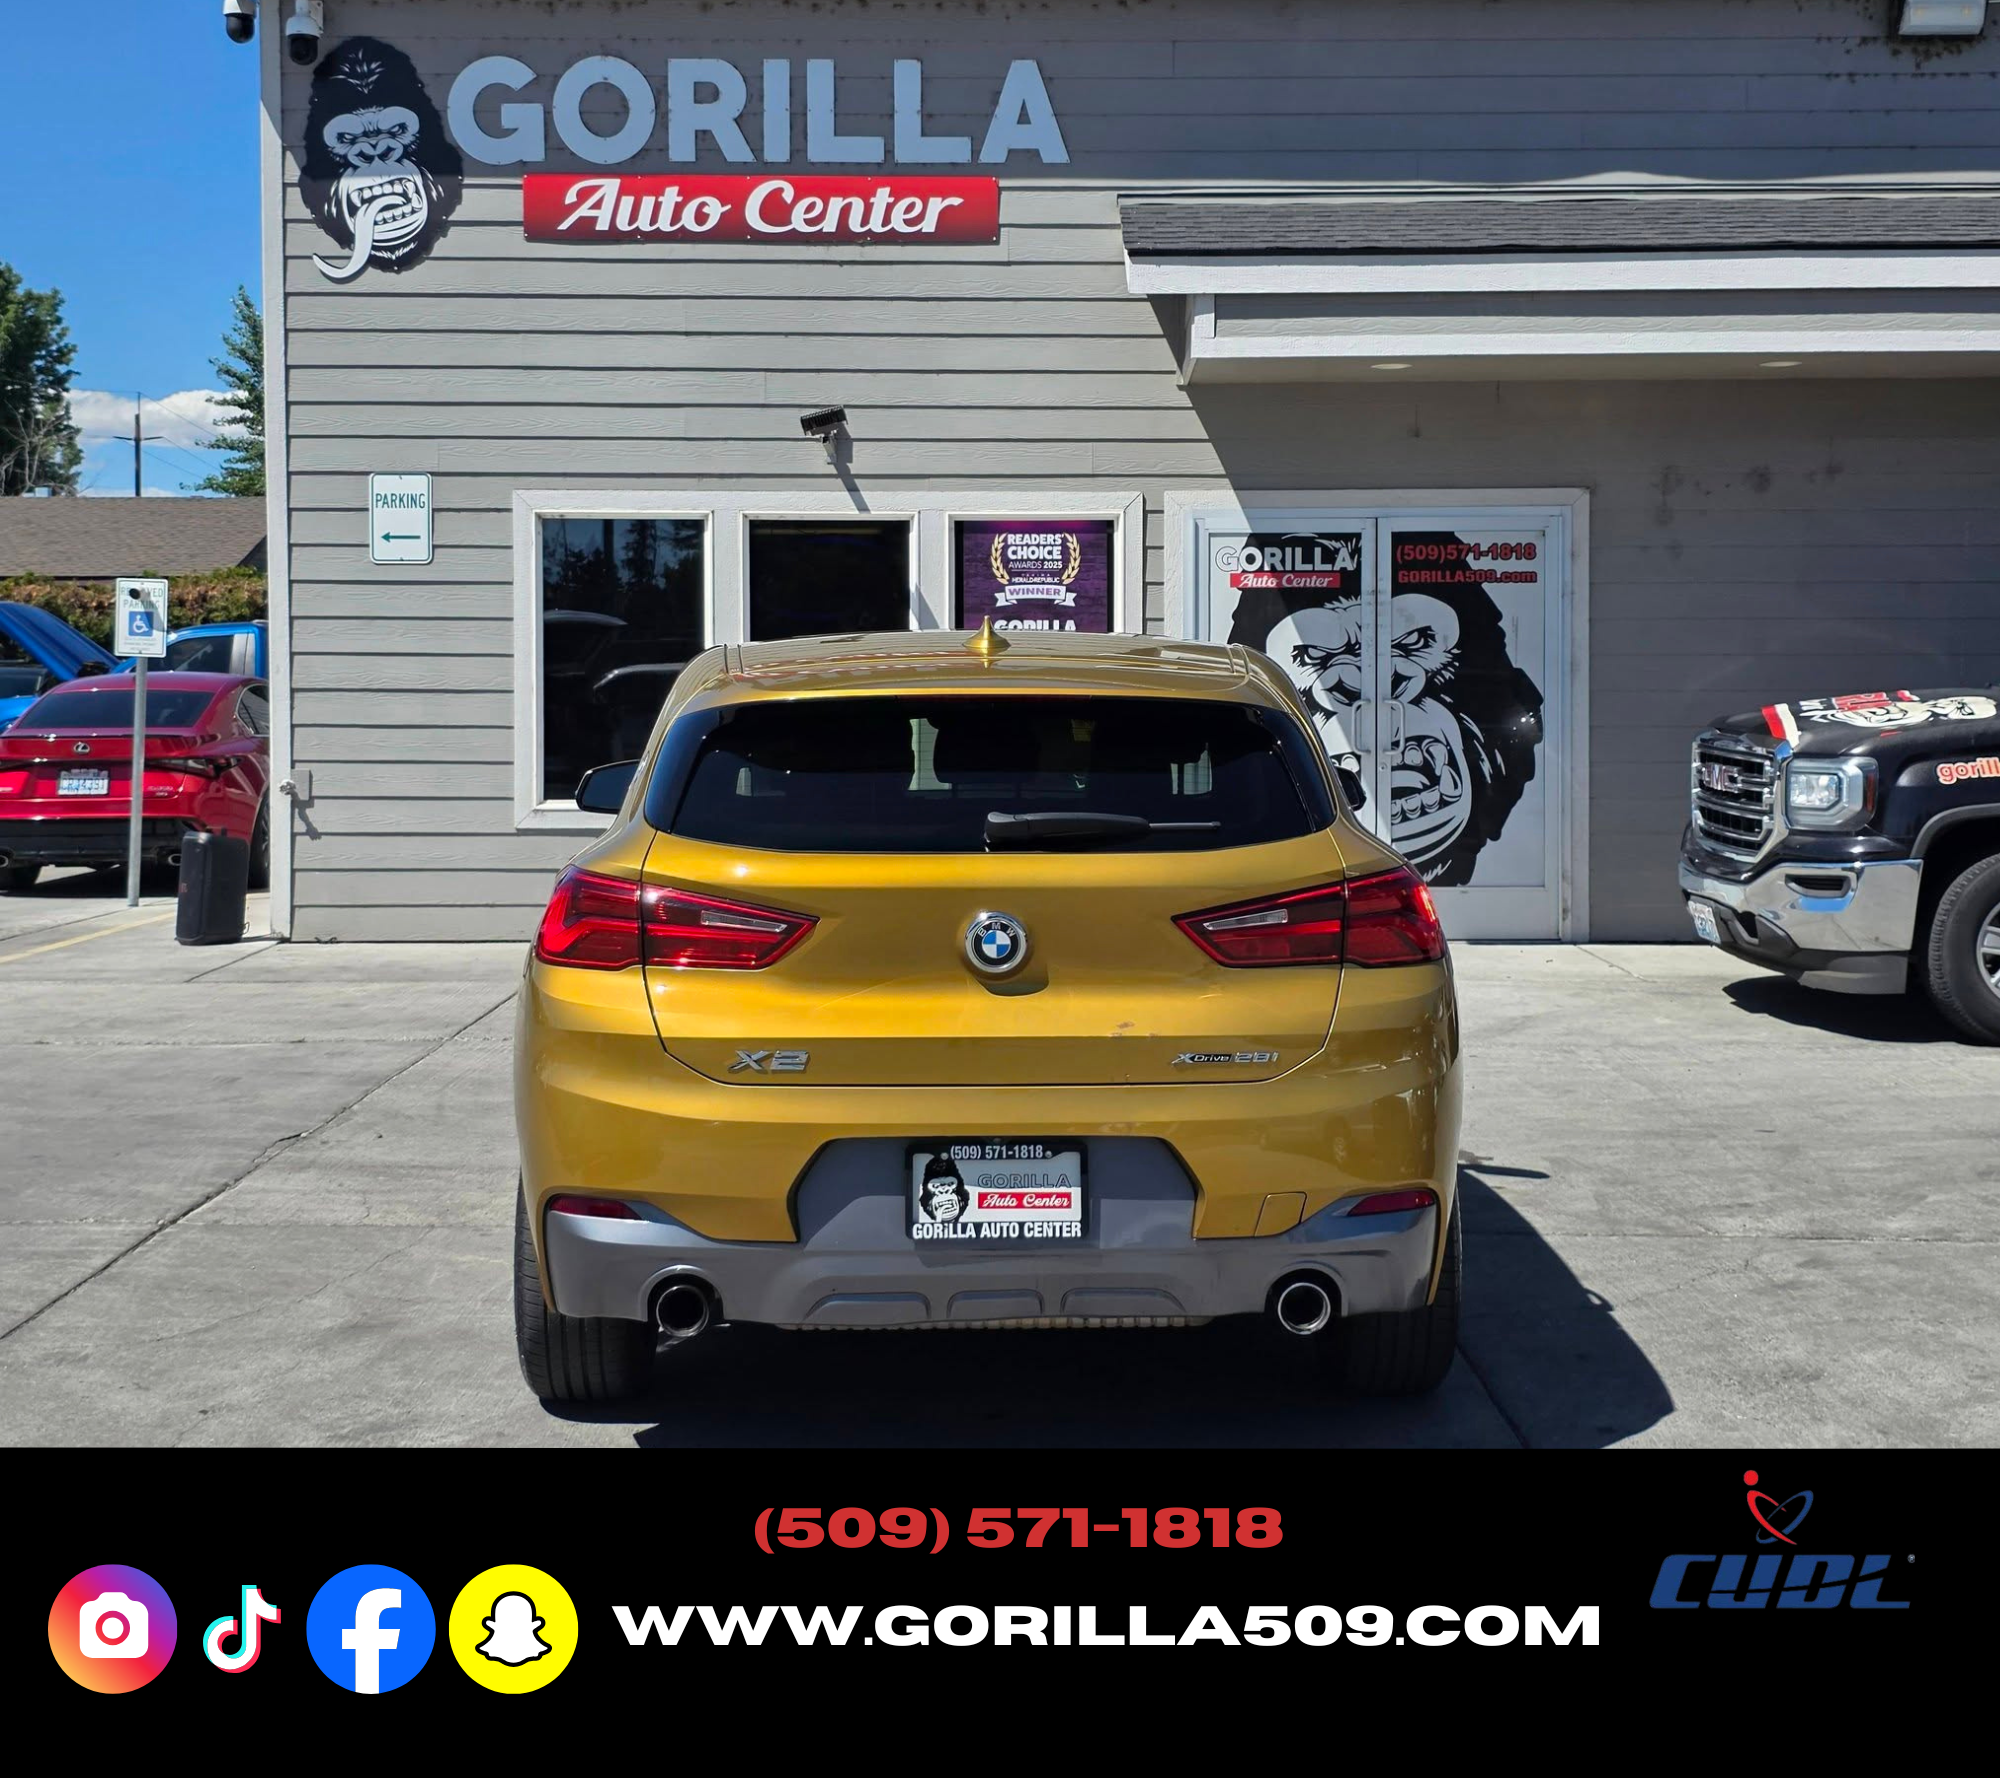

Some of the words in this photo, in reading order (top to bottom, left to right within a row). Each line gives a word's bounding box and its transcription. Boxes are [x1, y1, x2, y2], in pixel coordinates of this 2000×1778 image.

[447, 56, 1071, 165] GORILLA
[557, 178, 732, 233] Auto
[745, 180, 964, 234] Center
[375, 492, 426, 509] PARKING
[1007, 533, 1064, 545] READERS'
[1007, 545, 1062, 560] CHOICE
[1215, 546, 1355, 572] GORILLA
[1008, 561, 1042, 569] AWARDS
[1043, 561, 1063, 569] 2025
[1239, 573, 1278, 588] Auto
[1281, 573, 1333, 588] Center
[1008, 587, 1062, 597] WINNER
[978, 923, 1016, 937] BMW
[728, 1049, 809, 1071] X2
[950, 1145, 981, 1160] (509)
[985, 1145, 1043, 1159] 571-1818
[977, 1174, 1072, 1189] GORILLA
[982, 1193, 1018, 1207] Auto
[1022, 1193, 1070, 1208] Center
[980, 1222, 1020, 1239] AUTO
[1023, 1221, 1082, 1238] CENTER
